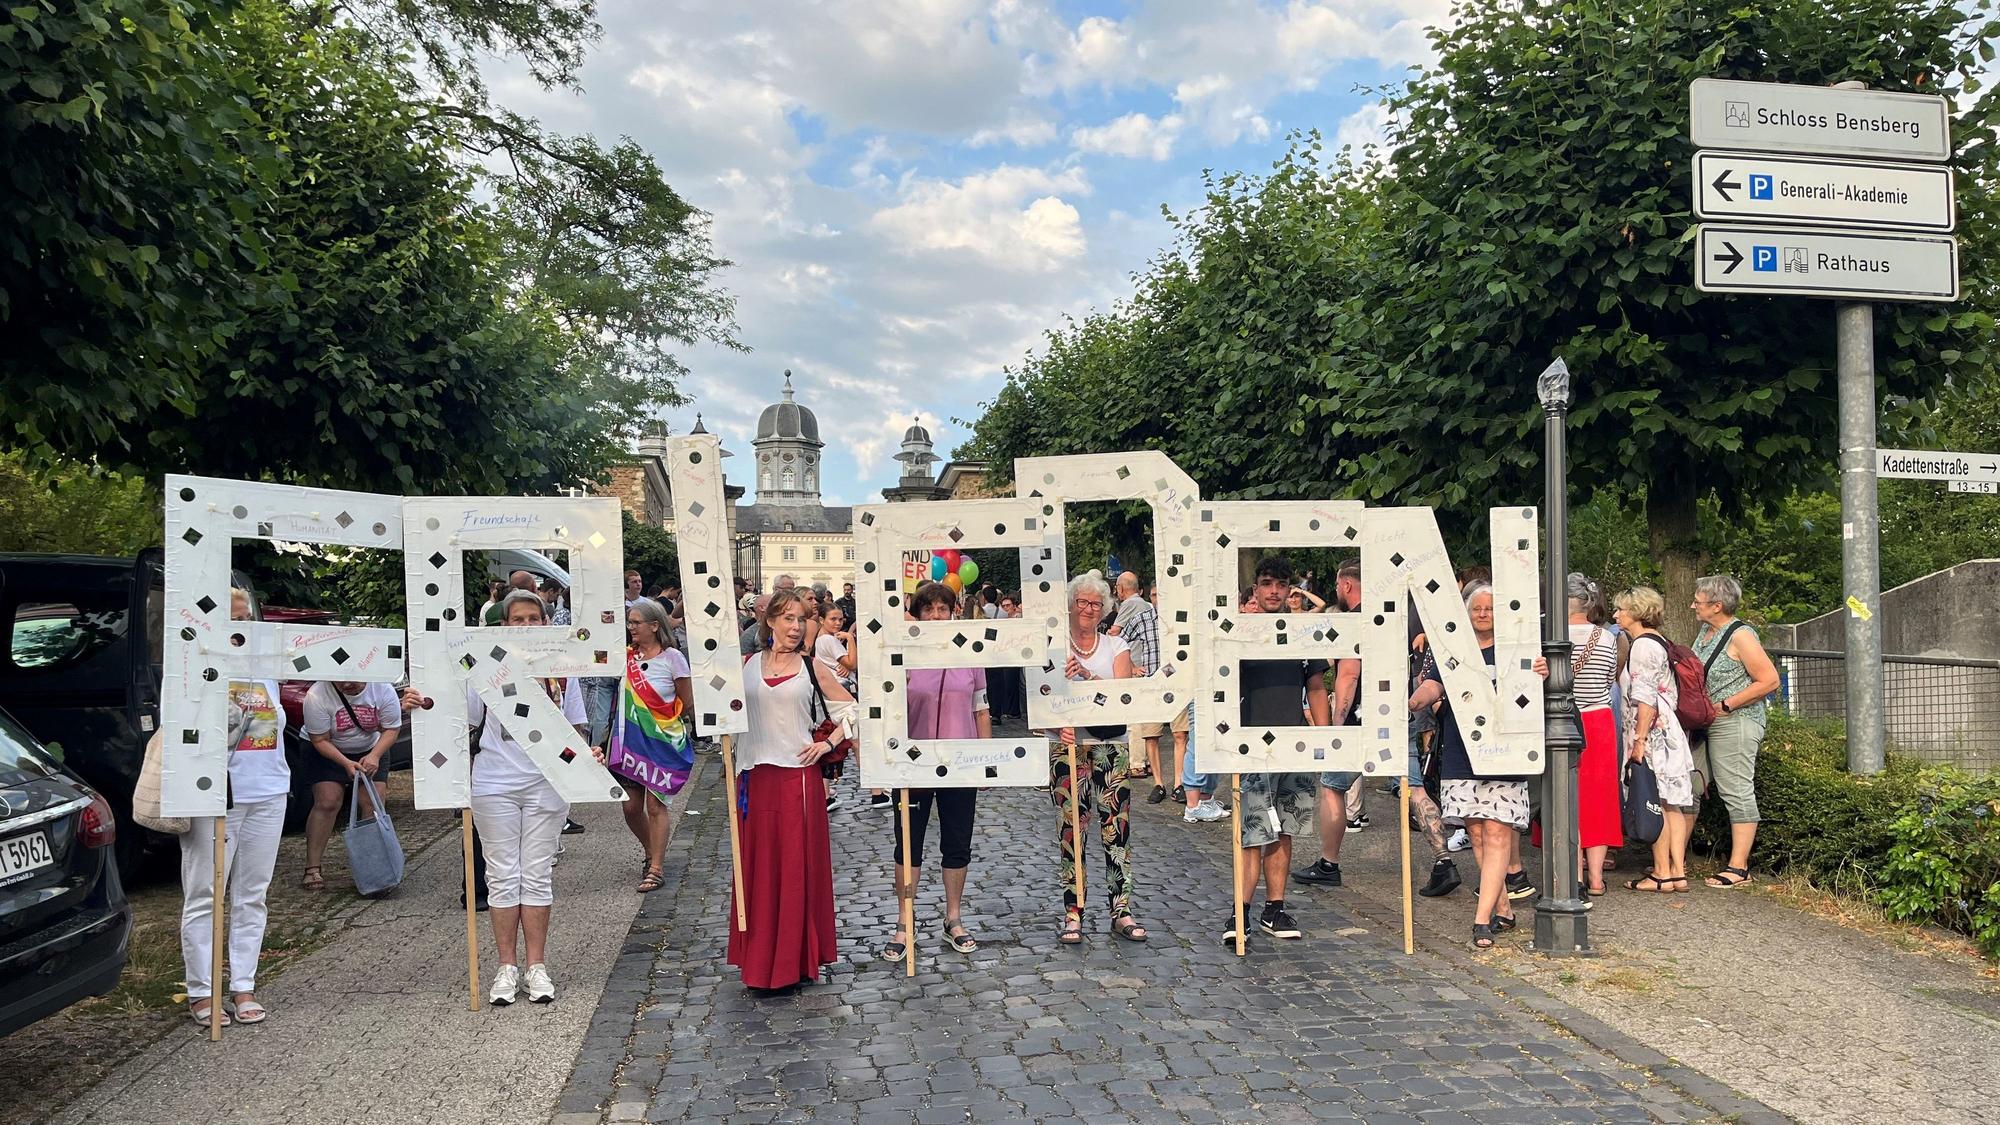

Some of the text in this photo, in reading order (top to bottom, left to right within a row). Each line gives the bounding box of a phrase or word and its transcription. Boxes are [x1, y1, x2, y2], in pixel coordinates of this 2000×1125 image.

[1757, 107, 1920, 138] Schloss Bensberg
[1754, 177, 1908, 205] P Generali-Akademie
[1758, 249, 1890, 273] P Rathaus
[1883, 455, 1969, 475] Kadettenstraße
[1956, 482, 1968, 492] 13
[1978, 483, 1990, 493] 15
[462, 508, 542, 530] Freundschaft
[904, 562, 927, 580] ER
[621, 752, 673, 790] PAIX
[8, 835, 51, 870] 5962
